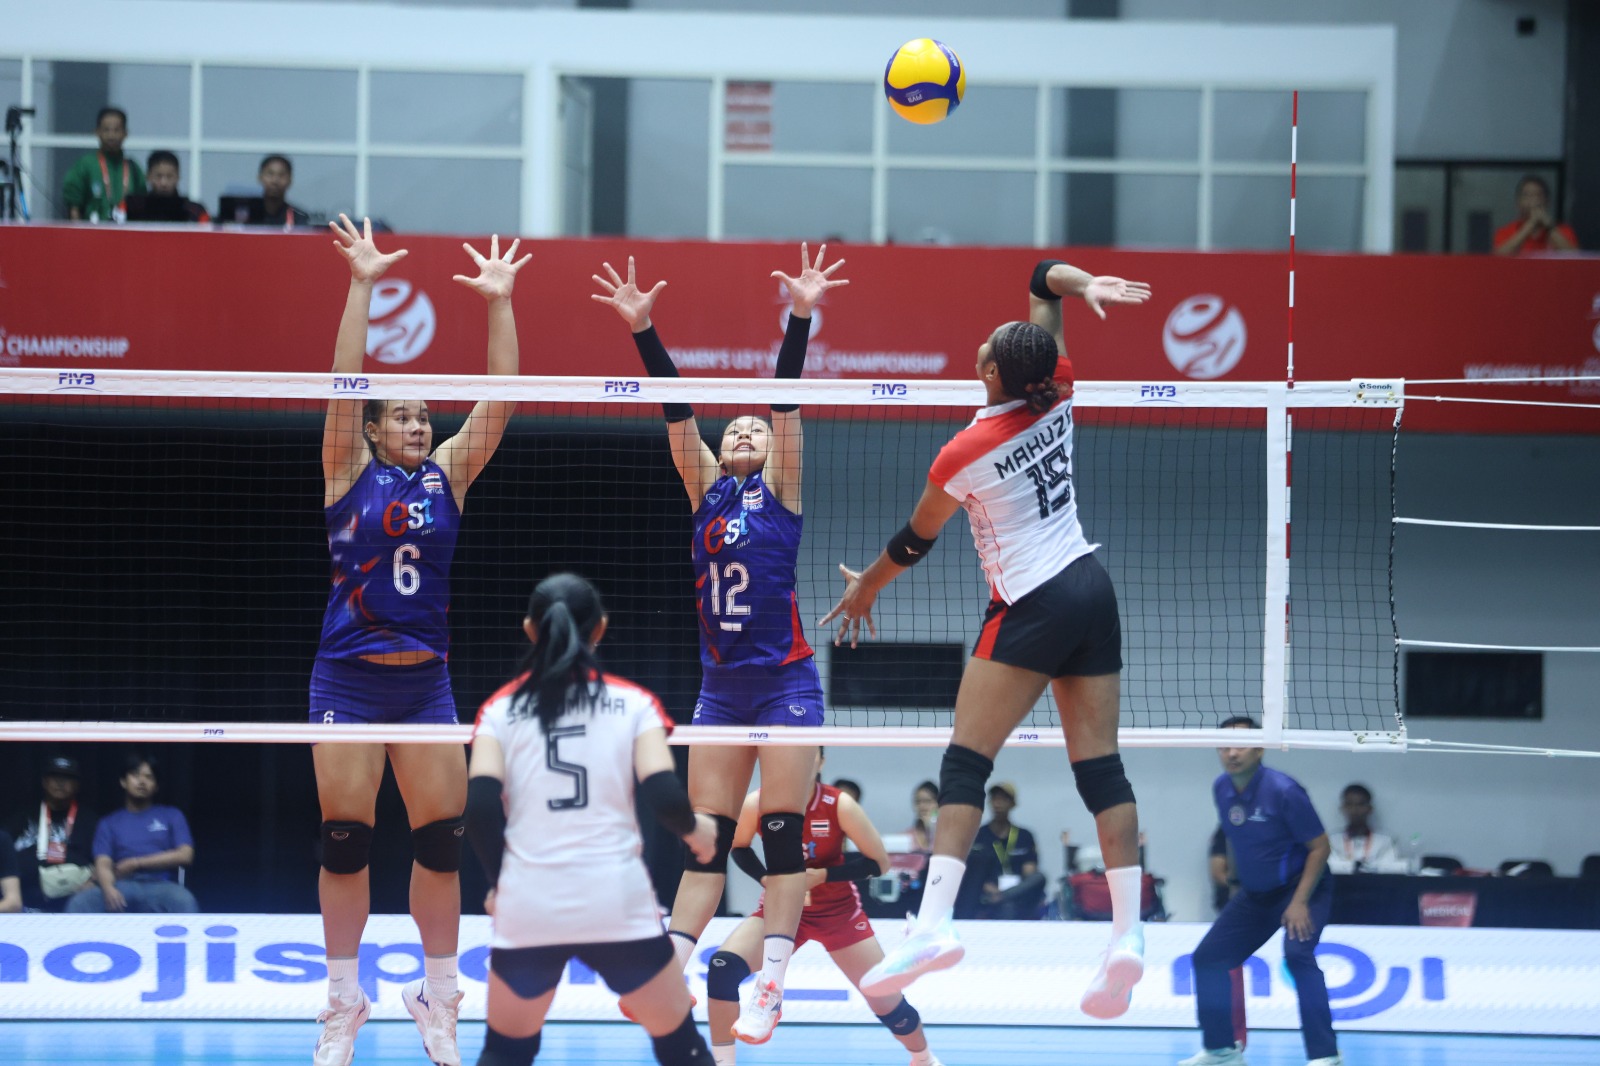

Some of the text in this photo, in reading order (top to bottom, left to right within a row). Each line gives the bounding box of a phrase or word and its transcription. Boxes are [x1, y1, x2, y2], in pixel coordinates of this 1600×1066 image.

[6, 335, 130, 358] CHAMPIONSHIP
[826, 351, 948, 375] CHAMPIONSHIP
[58, 372, 95, 385] FIVB
[333, 377, 369, 390] FIVB
[604, 381, 640, 393] FIVB
[872, 383, 907, 396] FIVB
[1141, 385, 1176, 398] FIVB
[1366, 383, 1393, 391] Senoh
[1025, 442, 1073, 520] 19
[382, 498, 434, 537] est
[703, 509, 750, 555] est
[736, 538, 751, 550] COLA
[393, 543, 421, 596] 6
[709, 561, 751, 616] 12
[323, 710, 335, 725] 6
[203, 728, 225, 736] FIVB
[748, 732, 769, 740] FIVB
[1018, 733, 1039, 741] FIVB
[546, 724, 589, 812] 5
[1423, 905, 1471, 918] MEDICAL
